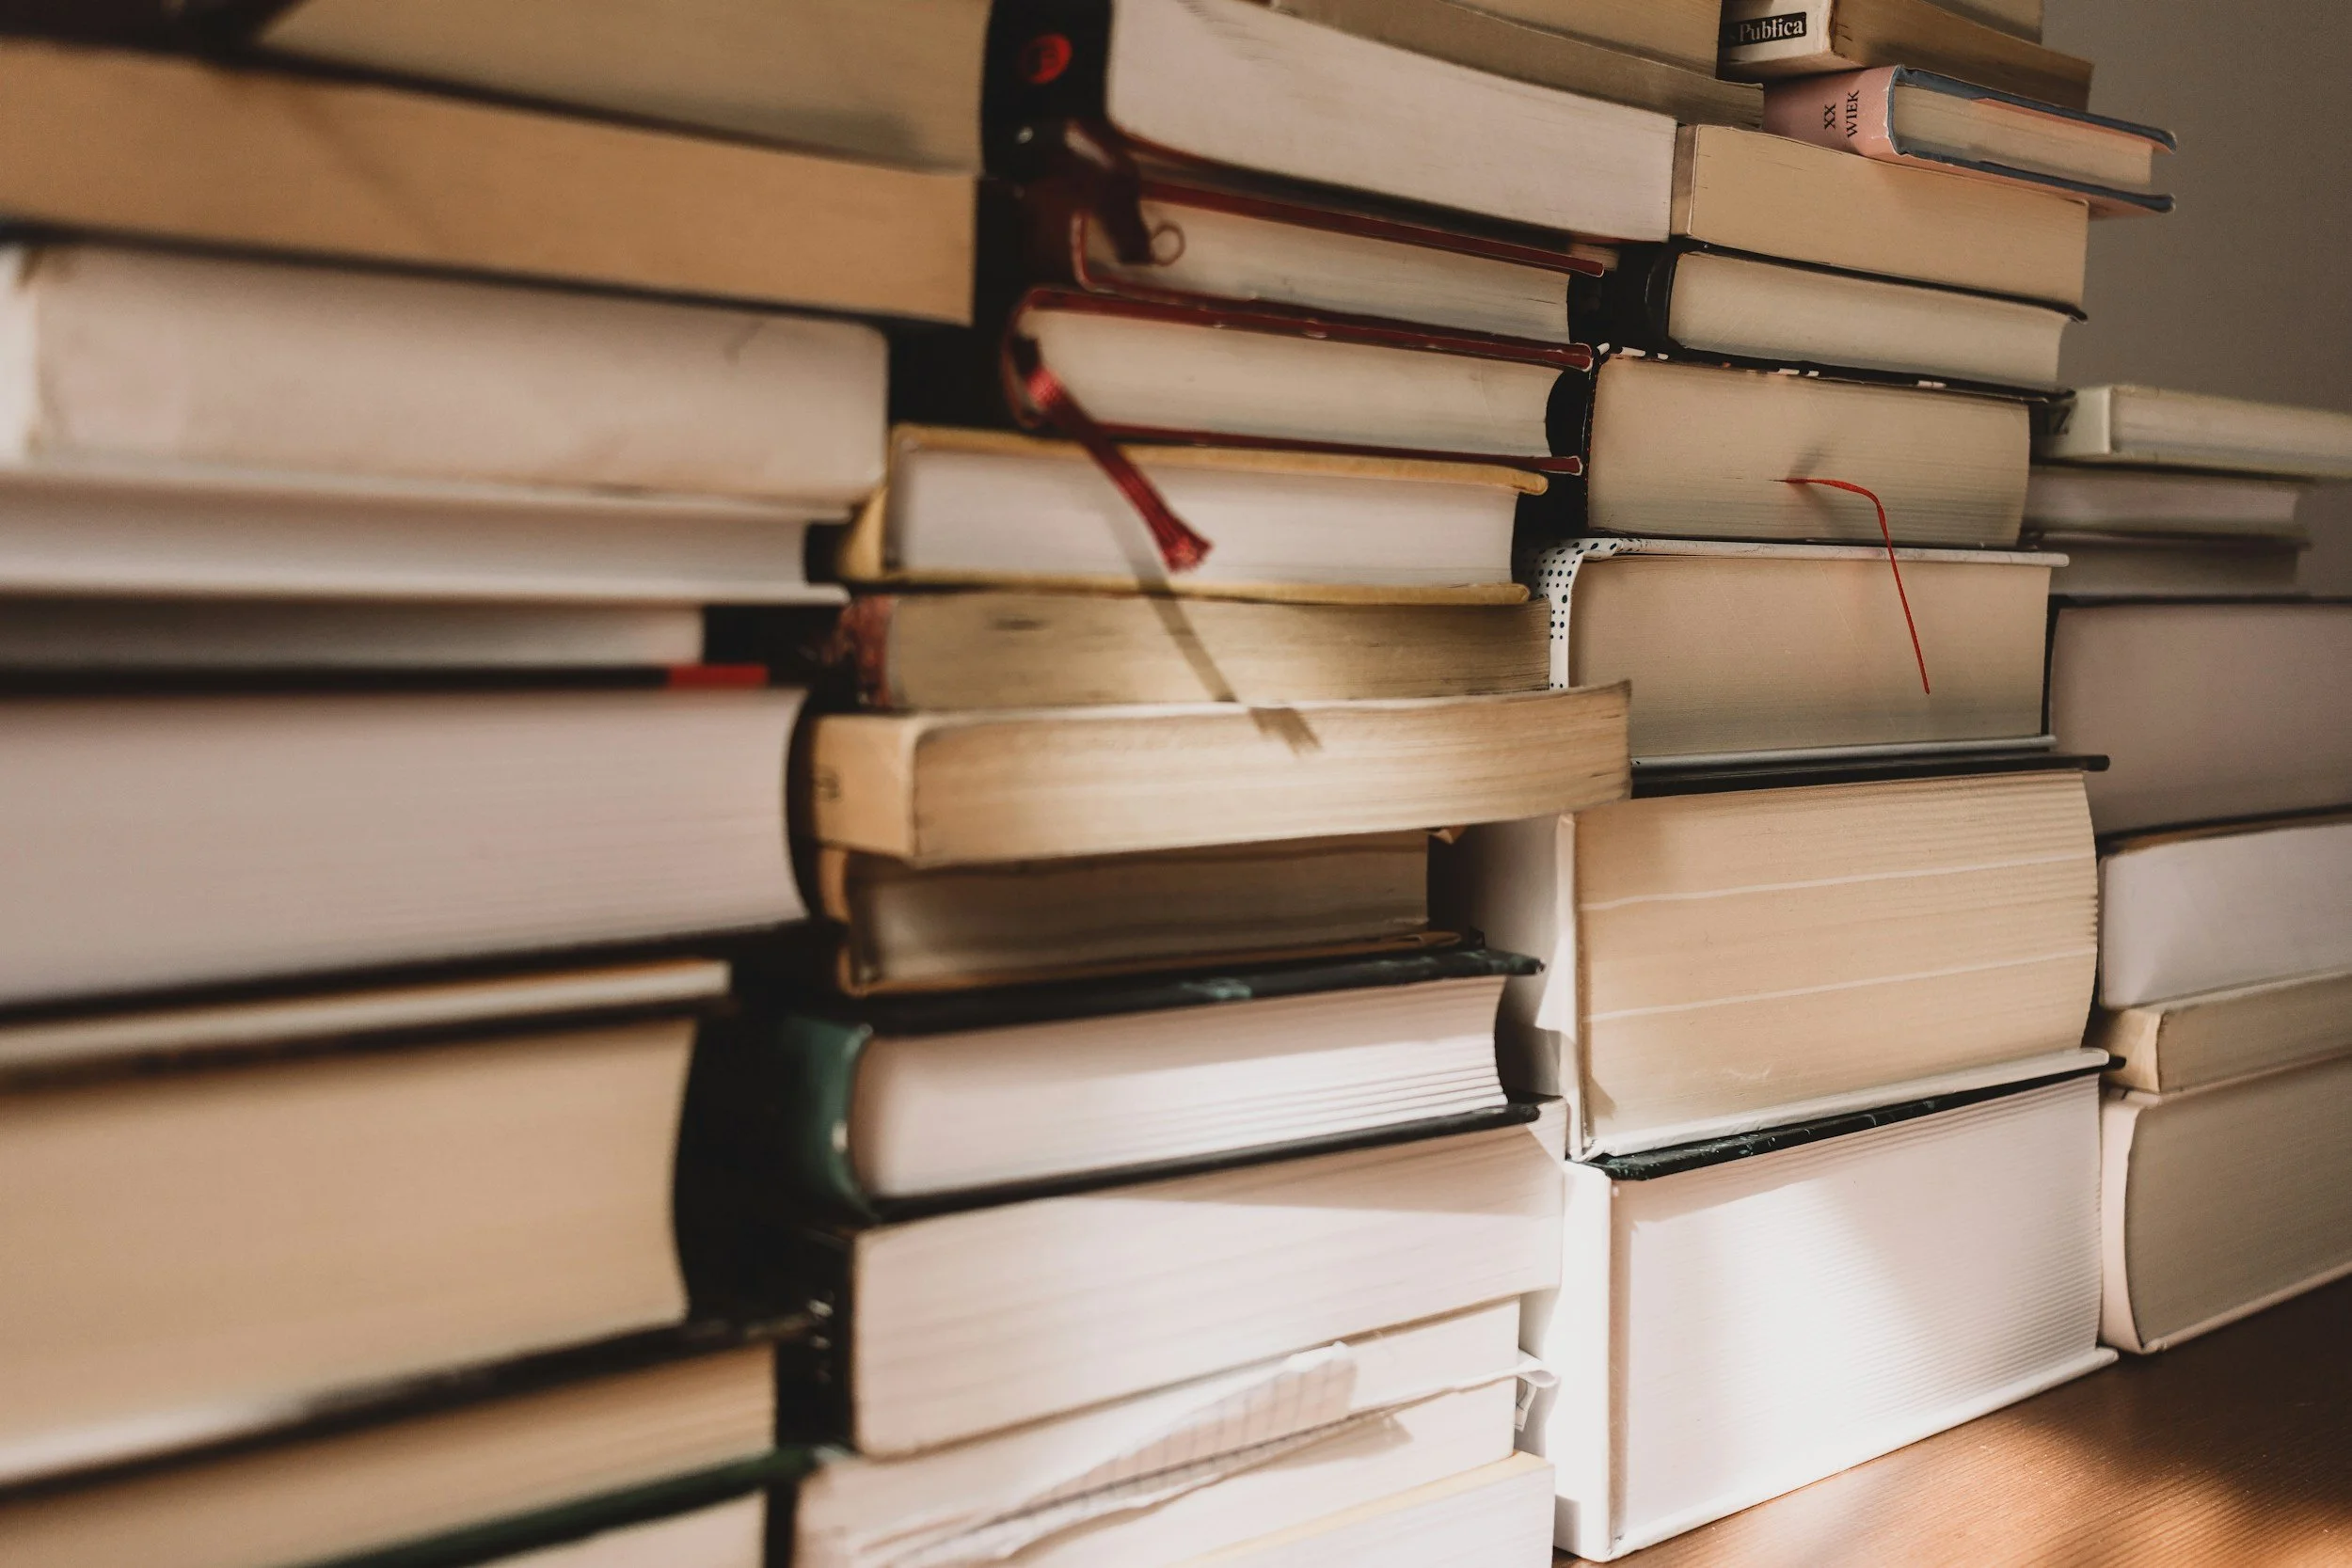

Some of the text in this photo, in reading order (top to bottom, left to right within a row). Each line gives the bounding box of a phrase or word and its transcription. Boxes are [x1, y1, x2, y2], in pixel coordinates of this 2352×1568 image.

[1740, 18, 1804, 42] Publica
[1824, 103, 1836, 130] XX
[1845, 89, 1860, 138] WIEK
